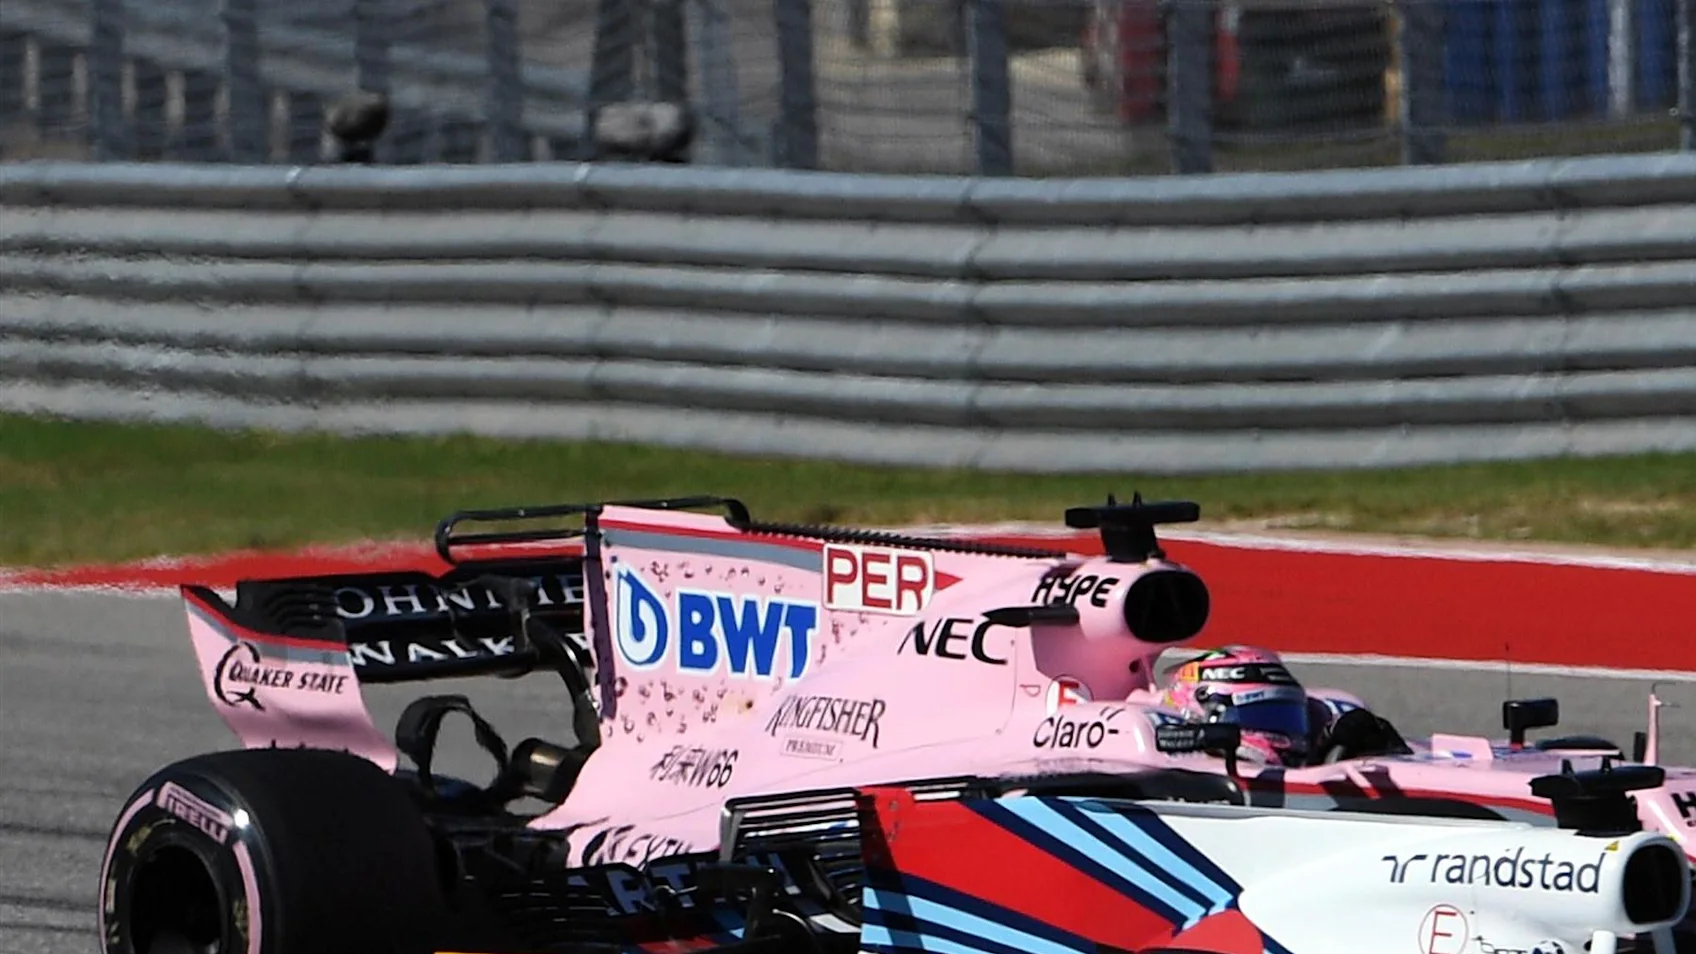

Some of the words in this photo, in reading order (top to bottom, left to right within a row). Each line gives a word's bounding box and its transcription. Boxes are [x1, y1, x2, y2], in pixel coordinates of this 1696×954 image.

[336, 575, 584, 619] OHNIE
[826, 554, 930, 612] PER
[1031, 574, 1120, 608] HYPE
[679, 592, 818, 678] BWT
[897, 617, 1009, 665] NEC
[229, 660, 295, 689] QUAKER
[297, 671, 349, 694] STATE
[1202, 666, 1246, 680] NEC
[765, 695, 887, 749] KINGFISHER
[1033, 715, 1105, 749] Claro
[1430, 847, 1607, 894] randstad
